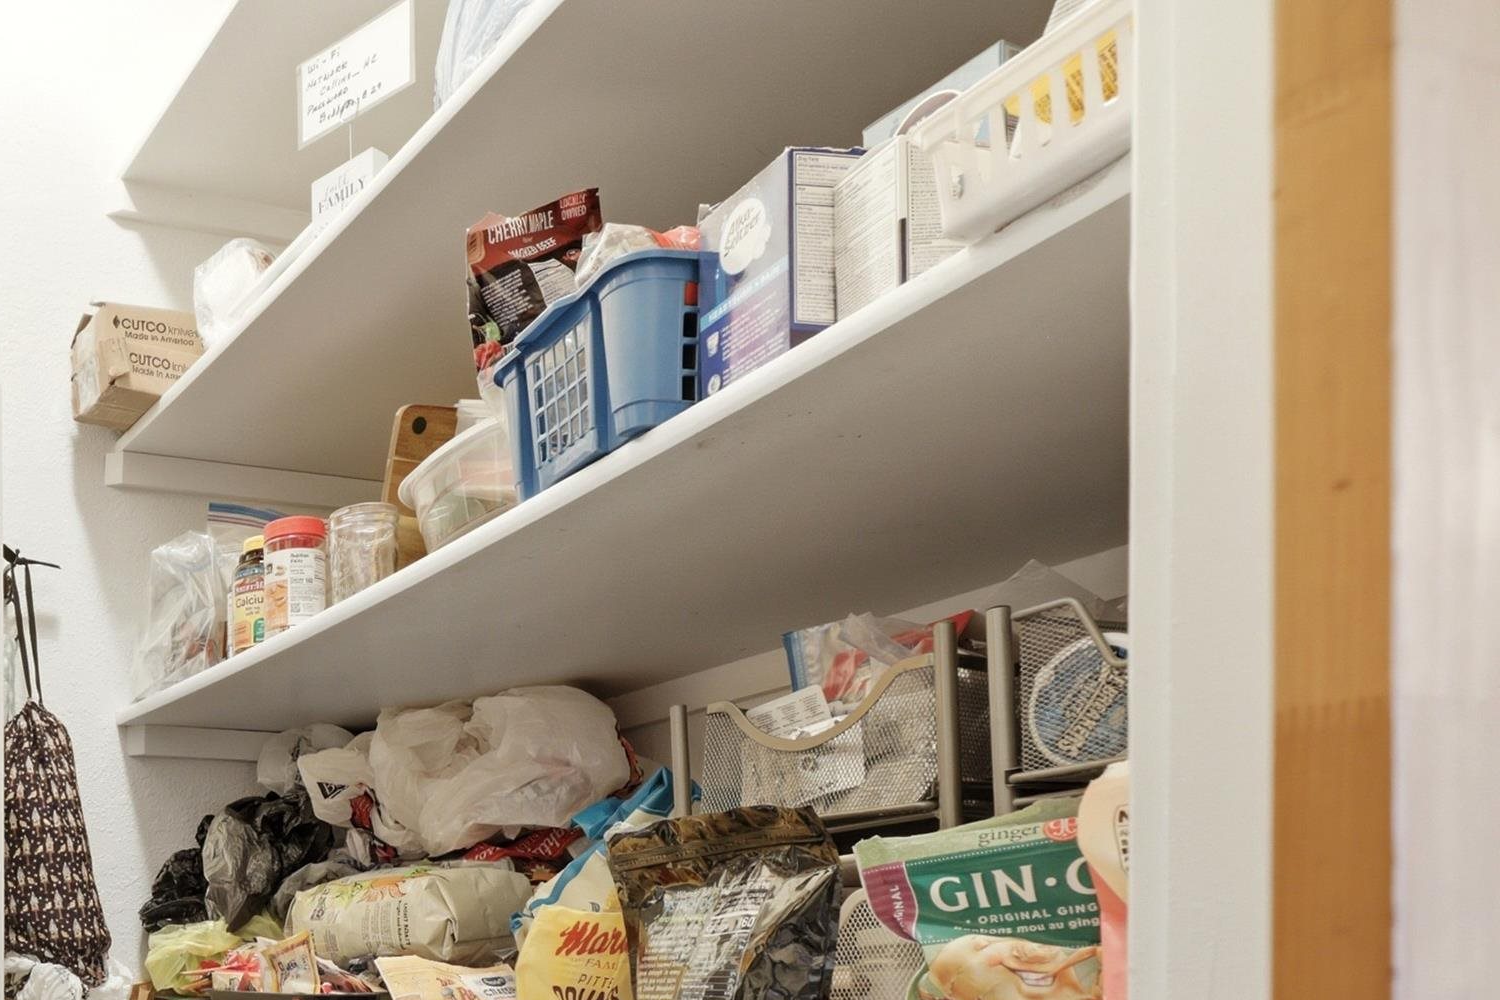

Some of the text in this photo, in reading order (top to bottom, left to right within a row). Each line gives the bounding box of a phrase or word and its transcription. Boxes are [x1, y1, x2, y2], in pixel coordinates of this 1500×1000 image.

[487, 210, 554, 244] CHERRY MAPLE
[121, 318, 166, 334] CUTCO
[125, 331, 149, 341] Made
[160, 336, 194, 346] America
[129, 352, 171, 370] CUTCO
[132, 365, 155, 377] Made
[978, 824, 1040, 848] ginger
[742, 917, 755, 929] 60
[978, 902, 1099, 927] ORIGINAL GING
[1017, 923, 1045, 935] mou
[1049, 920, 1064, 931] au
[1068, 917, 1100, 932] ging
